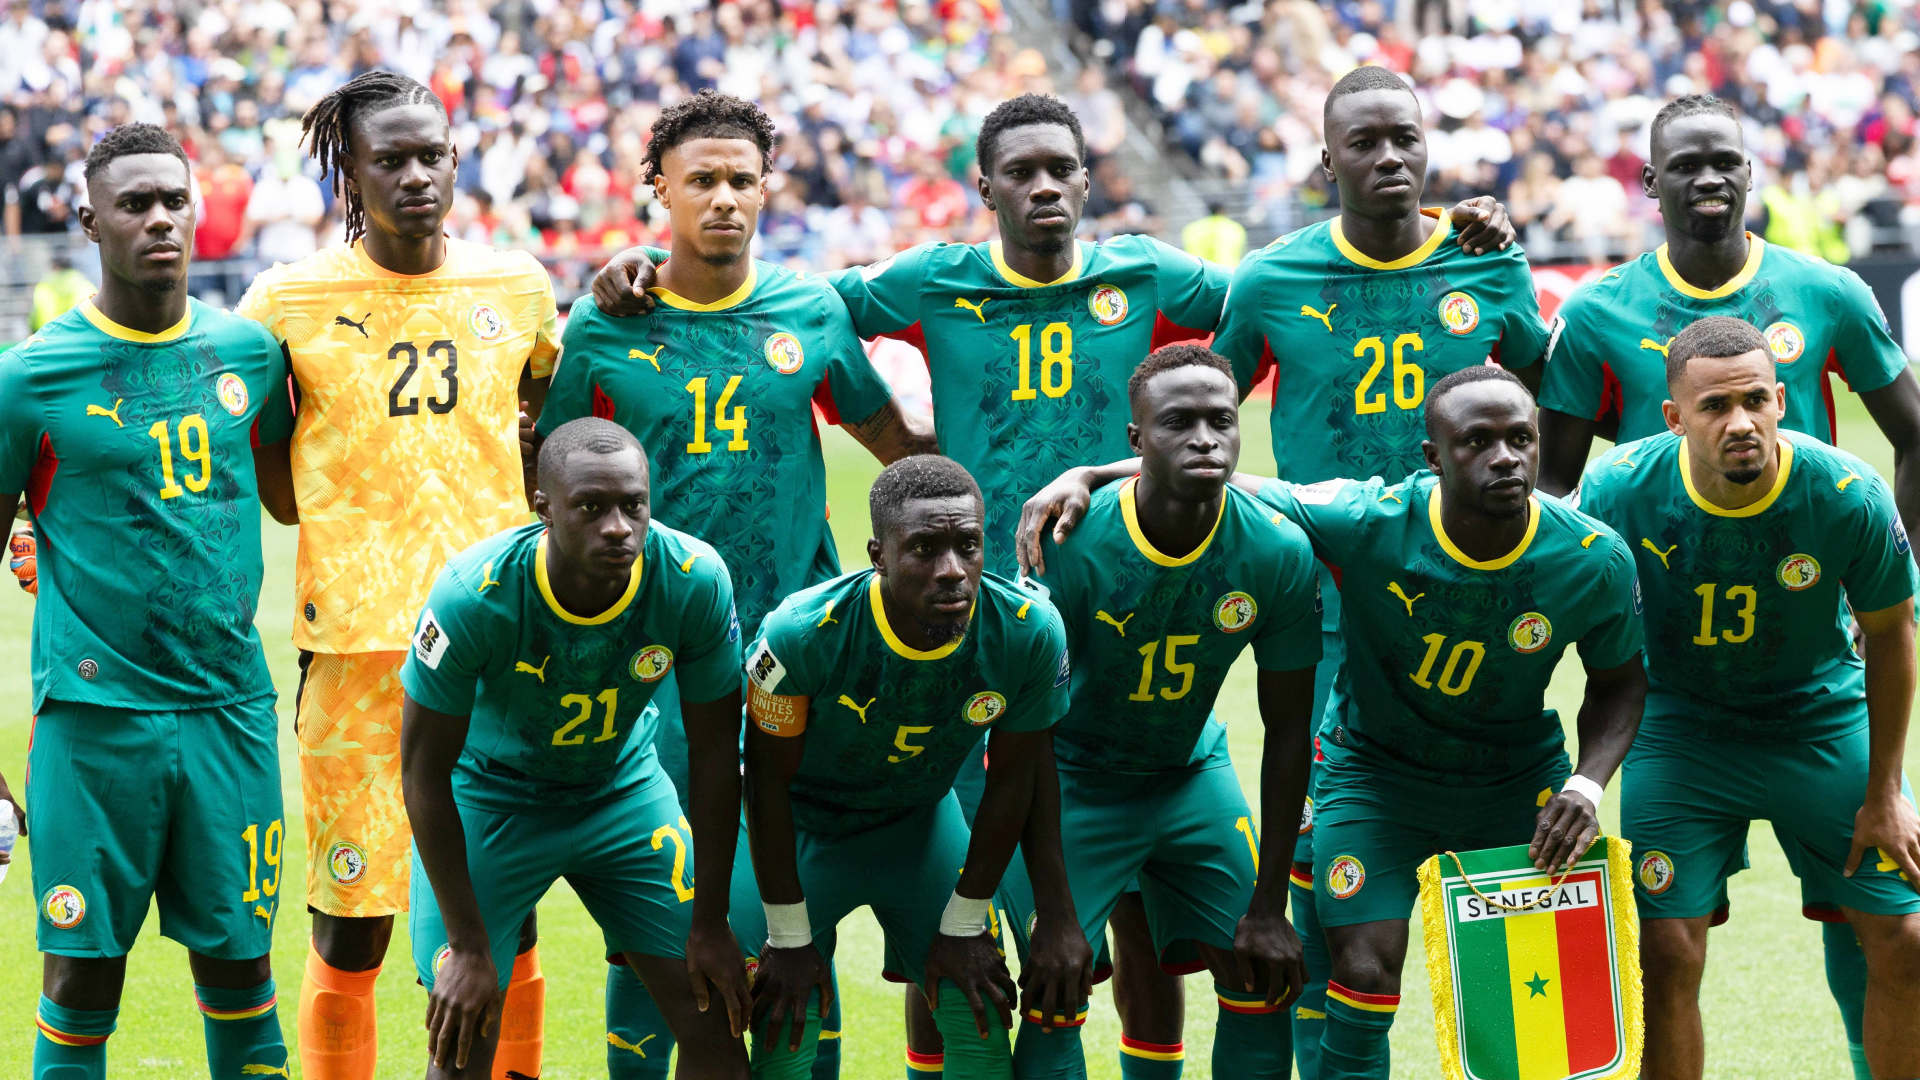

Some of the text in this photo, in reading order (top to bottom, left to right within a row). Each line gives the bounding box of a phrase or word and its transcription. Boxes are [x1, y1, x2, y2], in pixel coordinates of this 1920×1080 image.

[387, 339, 459, 416] 23
[1010, 321, 1074, 401] 18
[1353, 332, 1425, 415] 26
[685, 375, 749, 454] 14
[148, 413, 212, 500] 19
[1692, 583, 1758, 647] 13
[1128, 633, 1201, 703] 15
[1409, 632, 1486, 697] 10
[551, 687, 619, 746] 21
[752, 692, 793, 716] UNITES
[761, 721, 778, 731] FIFA
[764, 711, 796, 725] World
[887, 725, 933, 763] 5
[241, 819, 283, 902] 19
[1467, 885, 1589, 918] SENEGAL
